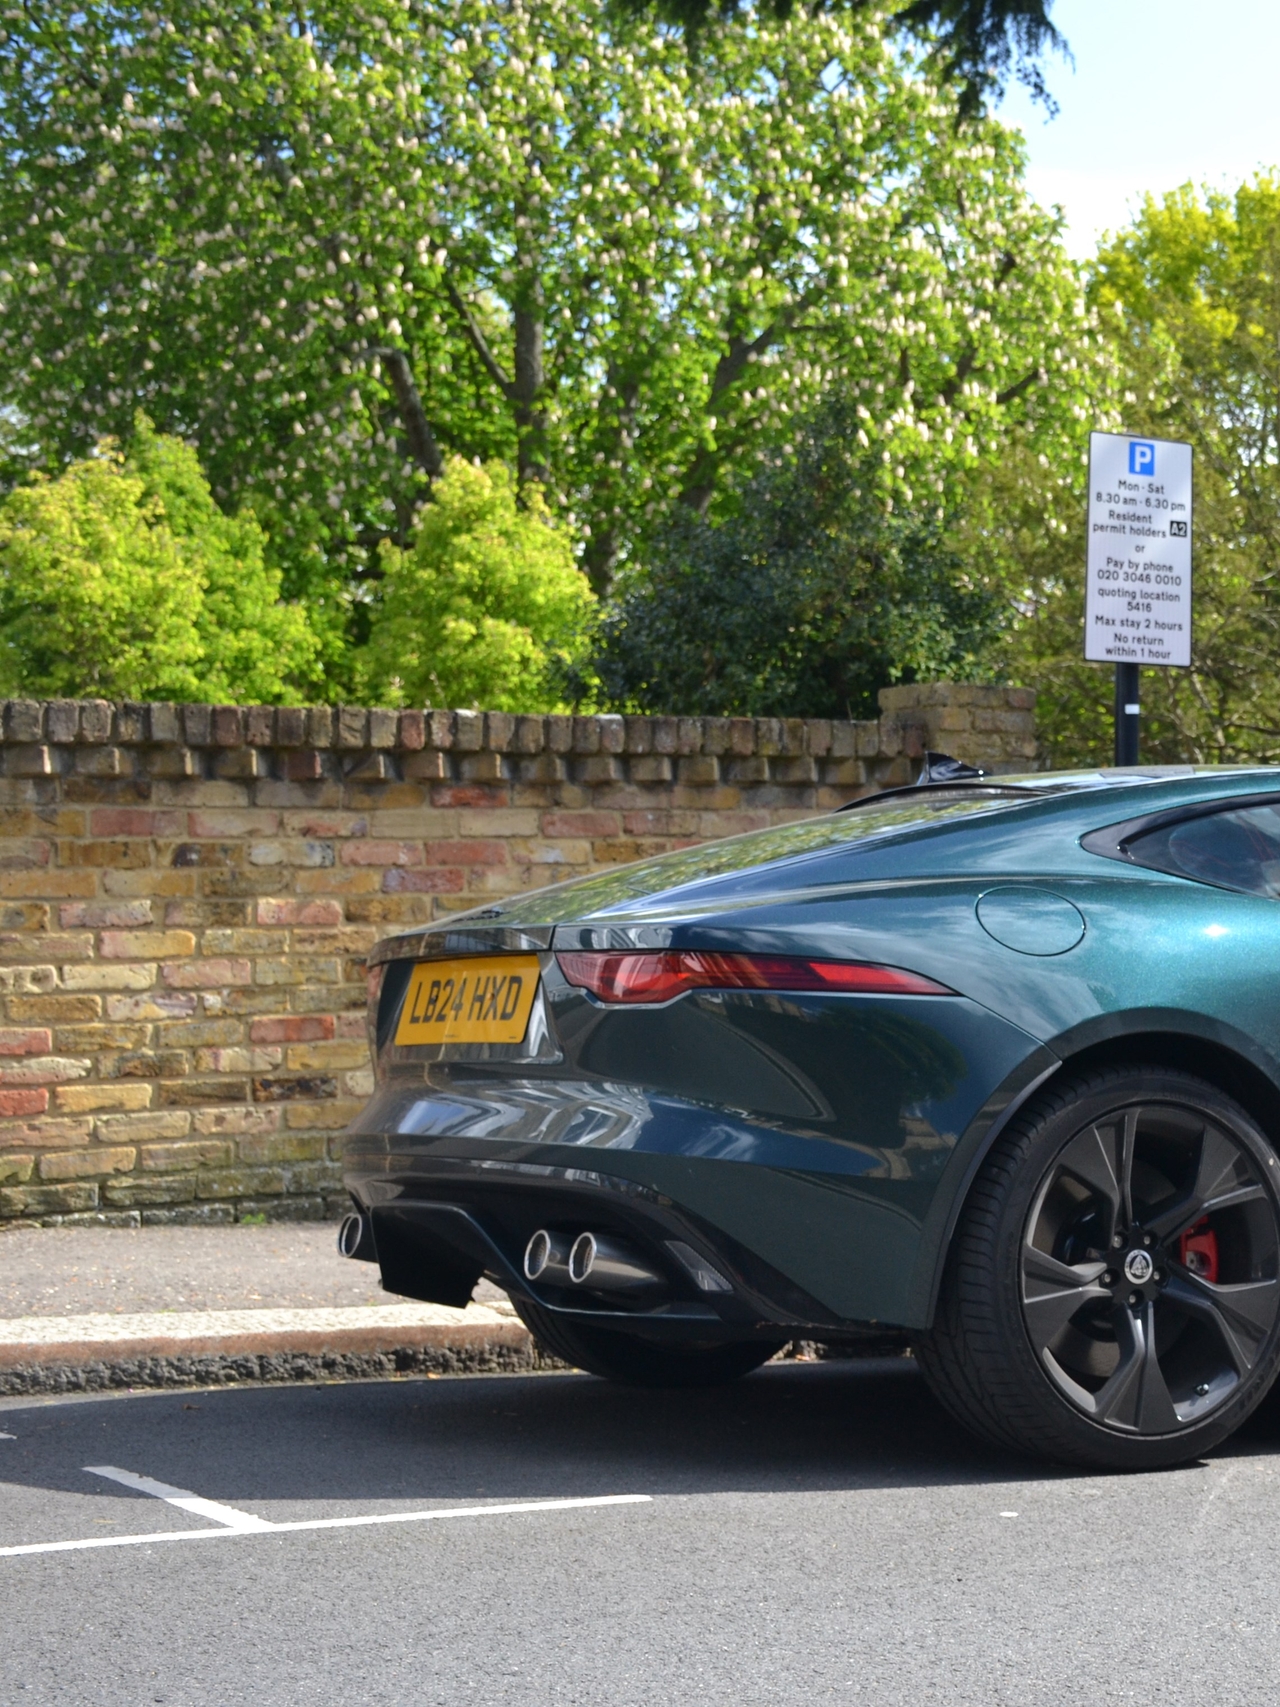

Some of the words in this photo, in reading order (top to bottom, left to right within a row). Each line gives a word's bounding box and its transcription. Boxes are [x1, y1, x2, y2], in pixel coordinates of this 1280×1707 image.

[1134, 446, 1152, 473] P
[1118, 480, 1140, 492] Mon
[1148, 484, 1164, 495] Sat
[1096, 492, 1120, 504] 8.30
[1122, 497, 1137, 506] am
[1145, 498, 1168, 510] 6.30
[1170, 503, 1186, 512] pm
[1108, 510, 1152, 524] Resident
[1093, 524, 1126, 534] permit
[1130, 526, 1166, 538] holders
[1172, 523, 1186, 536] A2
[1135, 545, 1145, 553] or
[1106, 557, 1124, 569] Pay
[1128, 560, 1140, 571] by
[1144, 562, 1174, 572] phone
[1098, 570, 1119, 580] 020
[1123, 572, 1151, 582] 3046
[1155, 575, 1182, 586] 0010
[1098, 588, 1136, 600] quoting
[1140, 590, 1180, 602] location
[1127, 602, 1152, 613] 5416
[1095, 615, 1116, 626] Max
[1120, 618, 1141, 630] stay
[1144, 618, 1151, 629] 2
[1154, 620, 1183, 631] hours
[1114, 634, 1128, 644] No
[1132, 636, 1164, 646] return
[1105, 647, 1137, 658] within
[1140, 649, 1145, 658] 1
[1148, 650, 1171, 660] hour
[409, 978, 467, 1024] LB24
[467, 975, 523, 1021] HXD
